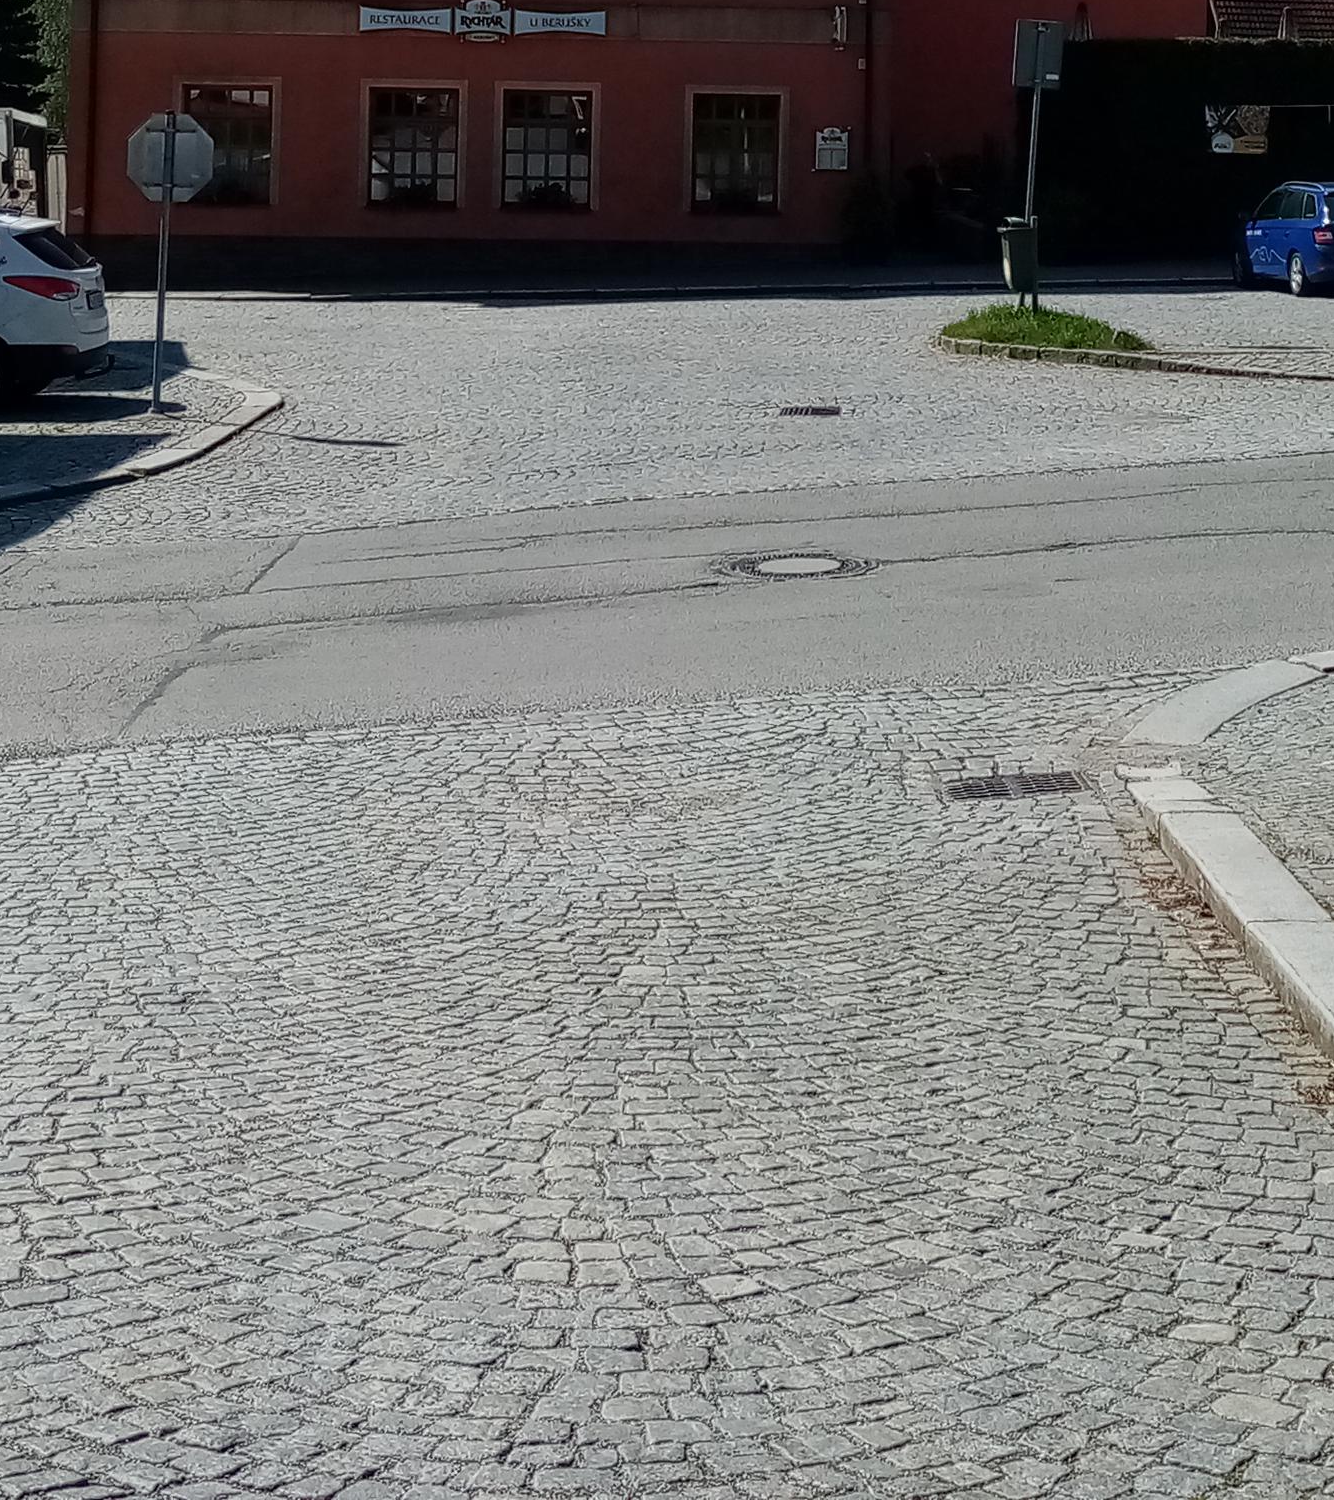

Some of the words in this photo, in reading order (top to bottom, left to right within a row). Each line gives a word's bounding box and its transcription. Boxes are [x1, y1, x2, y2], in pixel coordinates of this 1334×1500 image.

[369, 14, 440, 25] RESTAURACE
[530, 18, 538, 27] U
[542, 16, 591, 28] BERUŠKY
